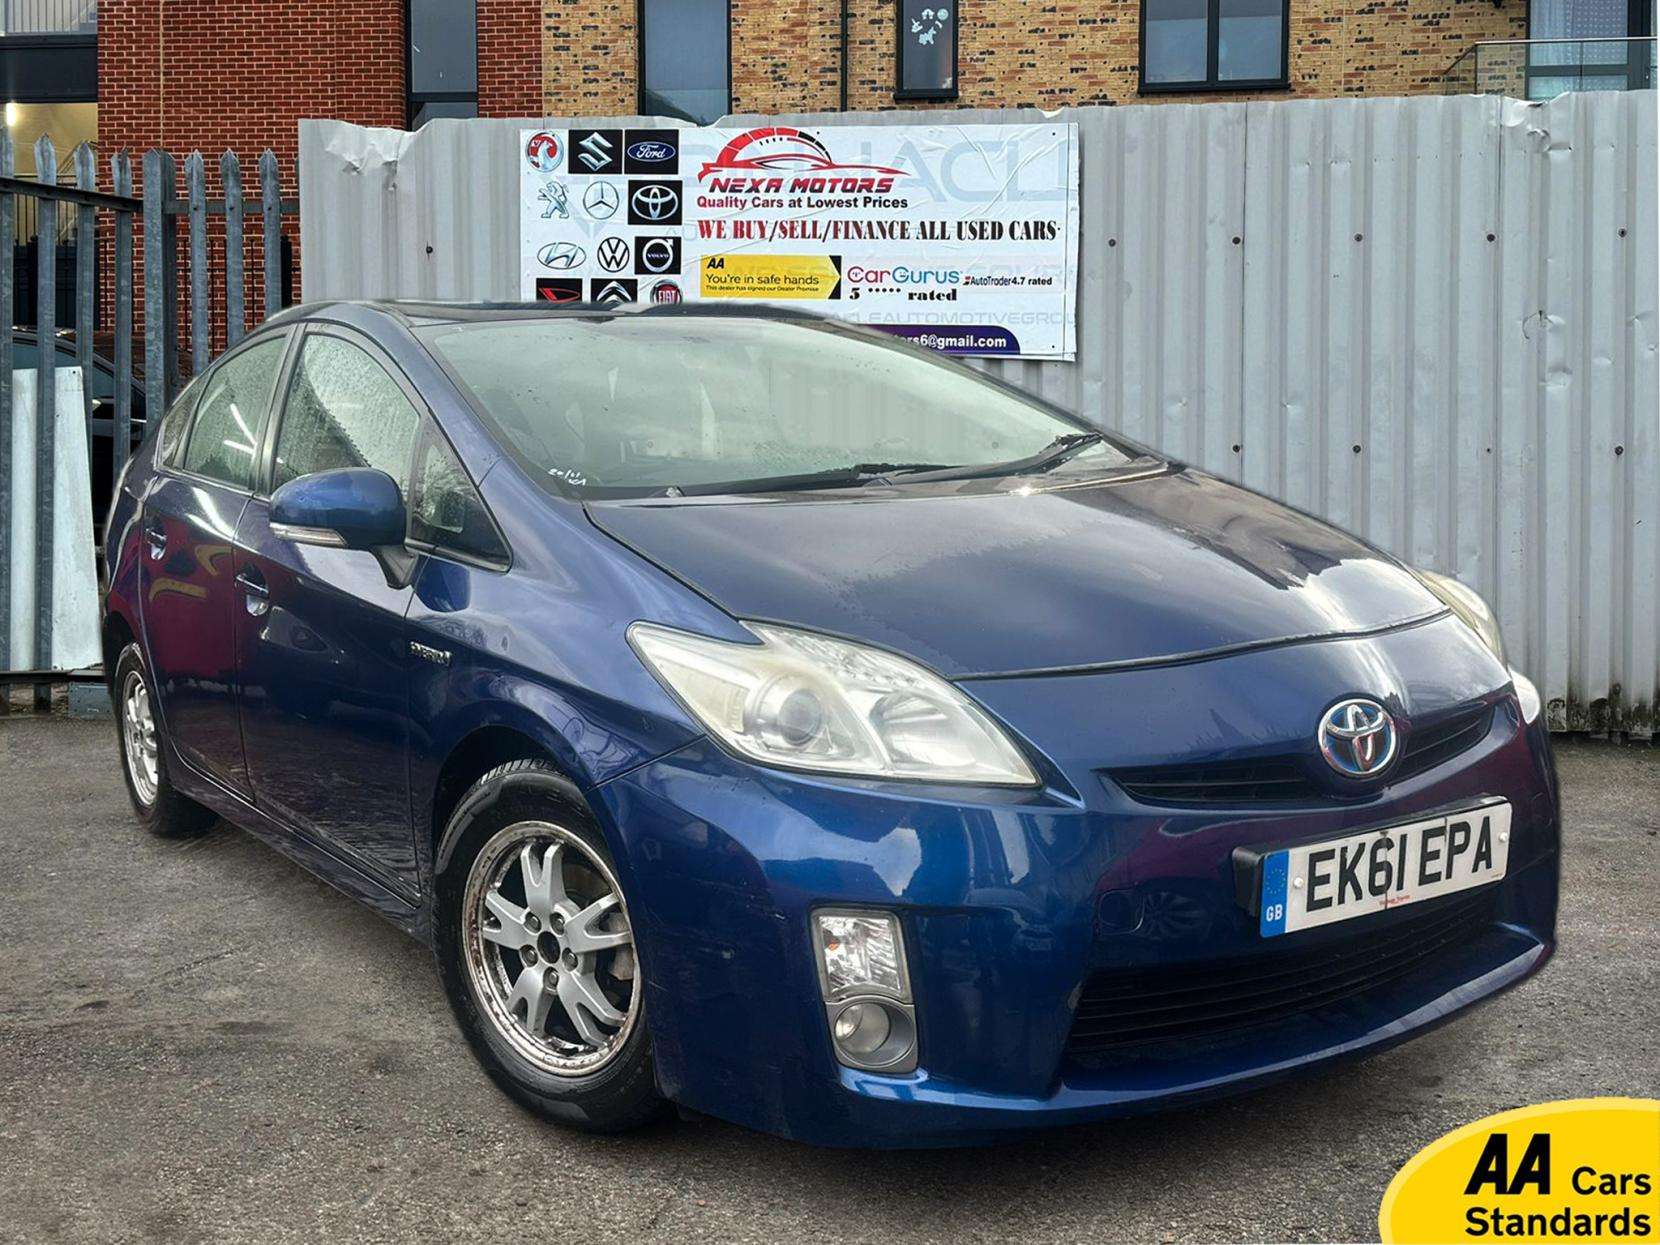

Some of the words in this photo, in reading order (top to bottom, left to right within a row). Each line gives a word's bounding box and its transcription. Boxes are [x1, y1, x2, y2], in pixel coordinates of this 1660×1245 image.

[636, 144, 665, 158] Ford
[709, 178, 784, 193] NEXA
[789, 178, 894, 193] MOTORS
[697, 195, 748, 210] Quality
[751, 196, 784, 208] Cars
[788, 197, 803, 208] at
[807, 196, 859, 208] Lowest
[863, 196, 909, 209] Prices
[697, 220, 727, 239] WE
[918, 220, 951, 240] ALL
[956, 220, 1004, 240] USED
[1008, 220, 1057, 240] CARS
[707, 257, 725, 269] AA
[705, 273, 741, 284] You're
[744, 274, 754, 284] in
[757, 273, 781, 285] safe
[784, 274, 820, 285] hands
[847, 266, 960, 284] CarGurus
[1028, 276, 1053, 286] rated
[849, 287, 860, 300] 5
[908, 288, 957, 301] rated
[1306, 833, 1408, 913] EK61
[1418, 815, 1493, 887] EPA
[1265, 903, 1283, 922] GB
